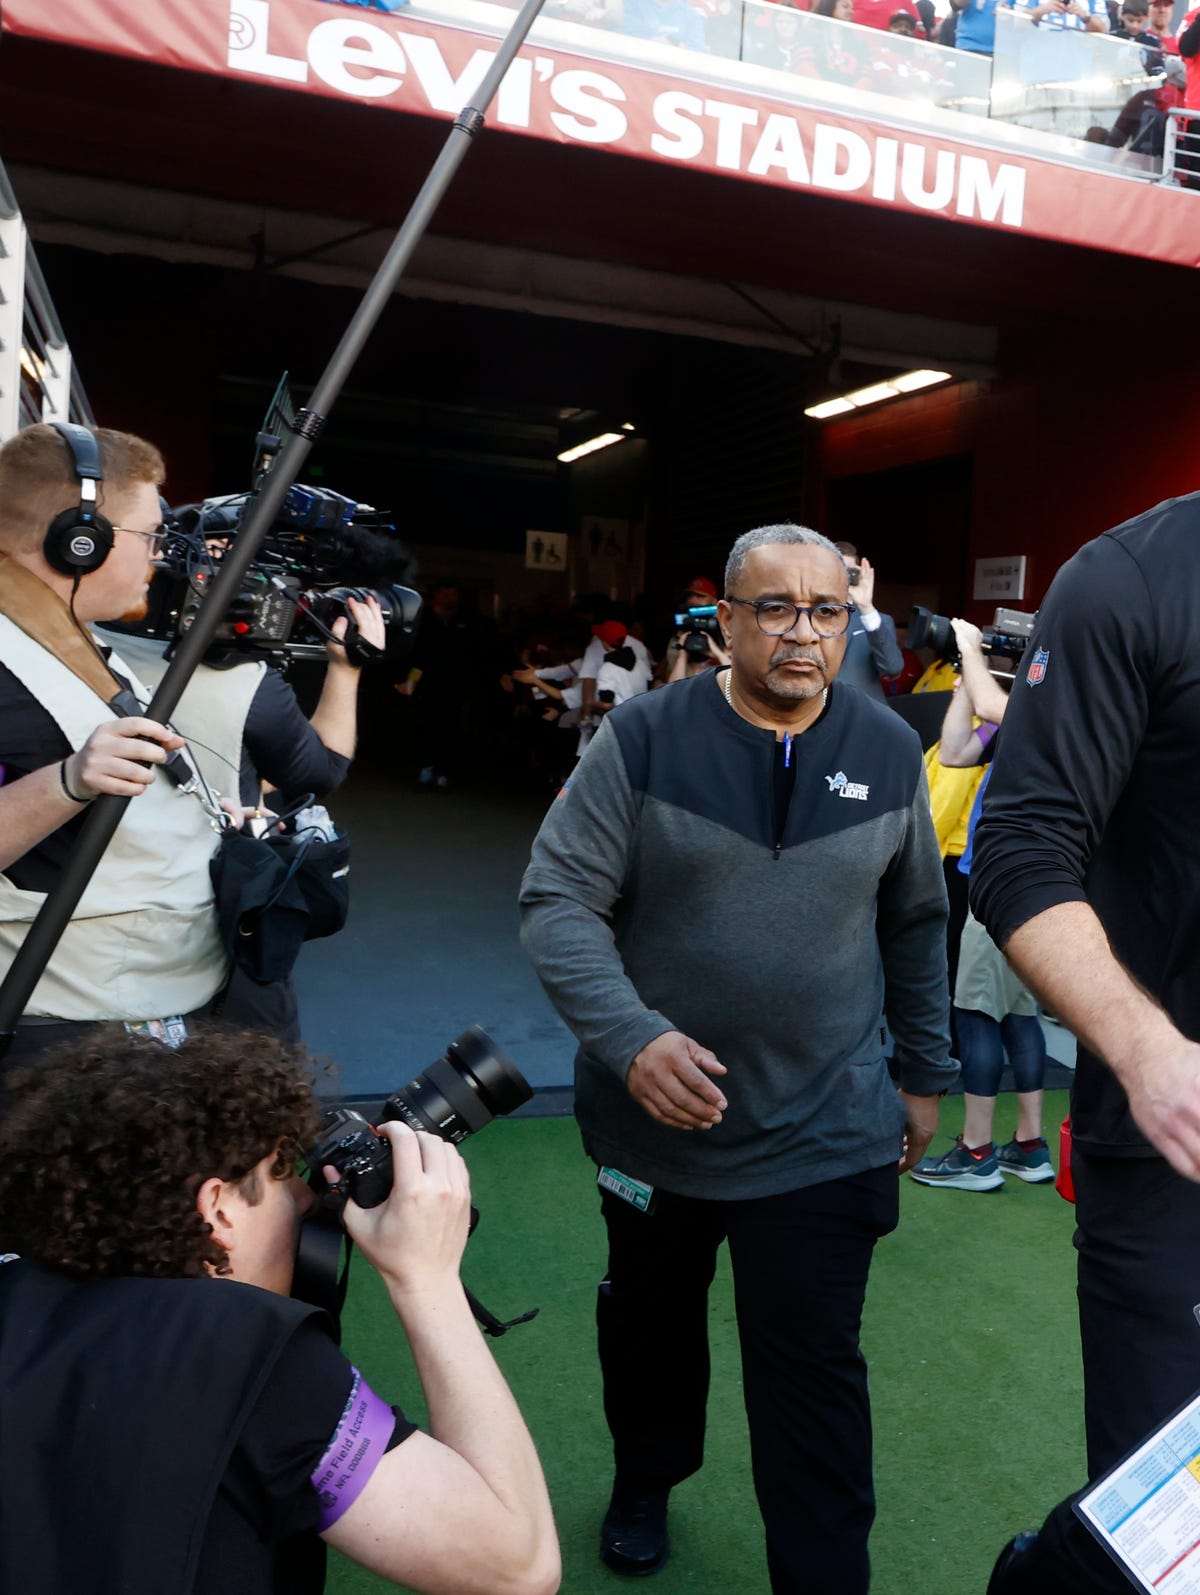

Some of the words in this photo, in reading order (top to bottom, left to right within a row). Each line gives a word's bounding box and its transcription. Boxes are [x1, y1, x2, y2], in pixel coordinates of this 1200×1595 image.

[651, 91, 1027, 228] STADIUM
[332, 1438, 354, 1469] Field
[348, 1400, 369, 1438] Access
[334, 1473, 351, 1490] NFL
